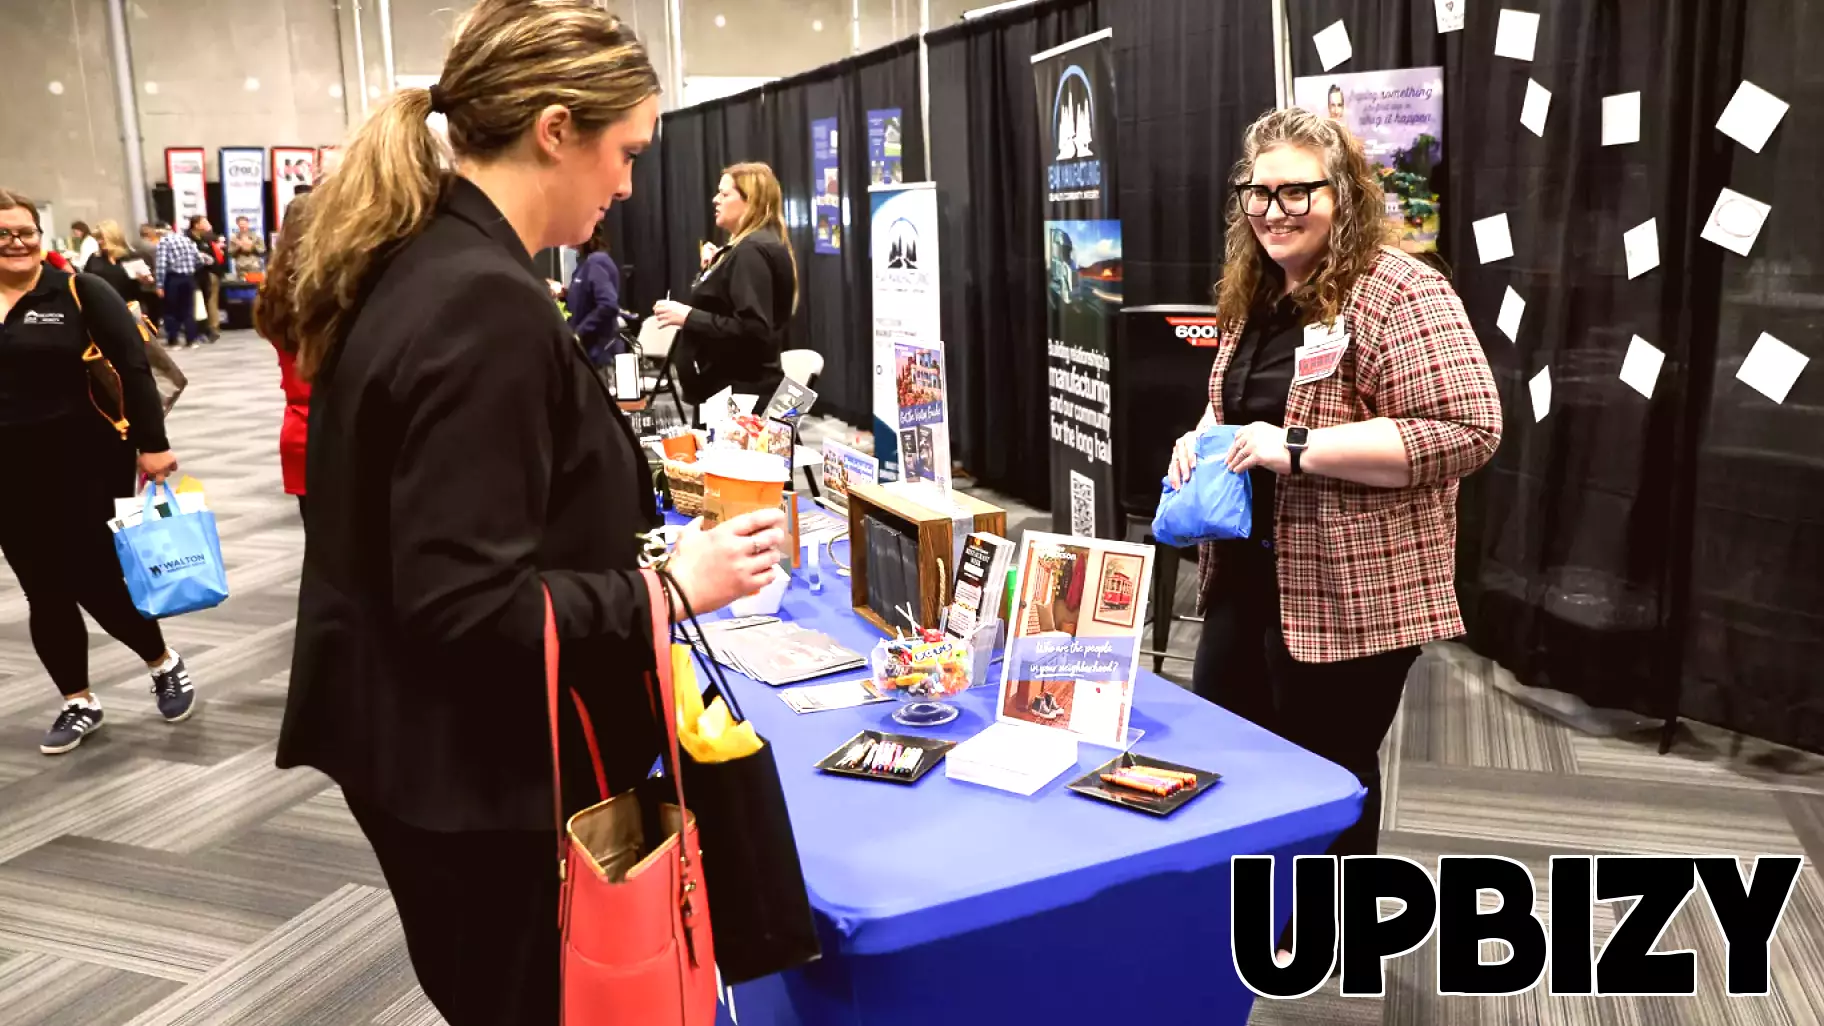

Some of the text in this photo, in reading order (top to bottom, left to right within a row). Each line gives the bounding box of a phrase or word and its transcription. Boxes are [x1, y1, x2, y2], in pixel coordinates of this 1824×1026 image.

[1048, 365, 1111, 415] manufacturing
[1049, 394, 1064, 414] and
[1075, 404, 1111, 439] community
[1051, 414, 1112, 465] for the long haul
[163, 553, 205, 569] WALTON
[1036, 640, 1113, 658] Who are the people
[1039, 664, 1058, 675] your
